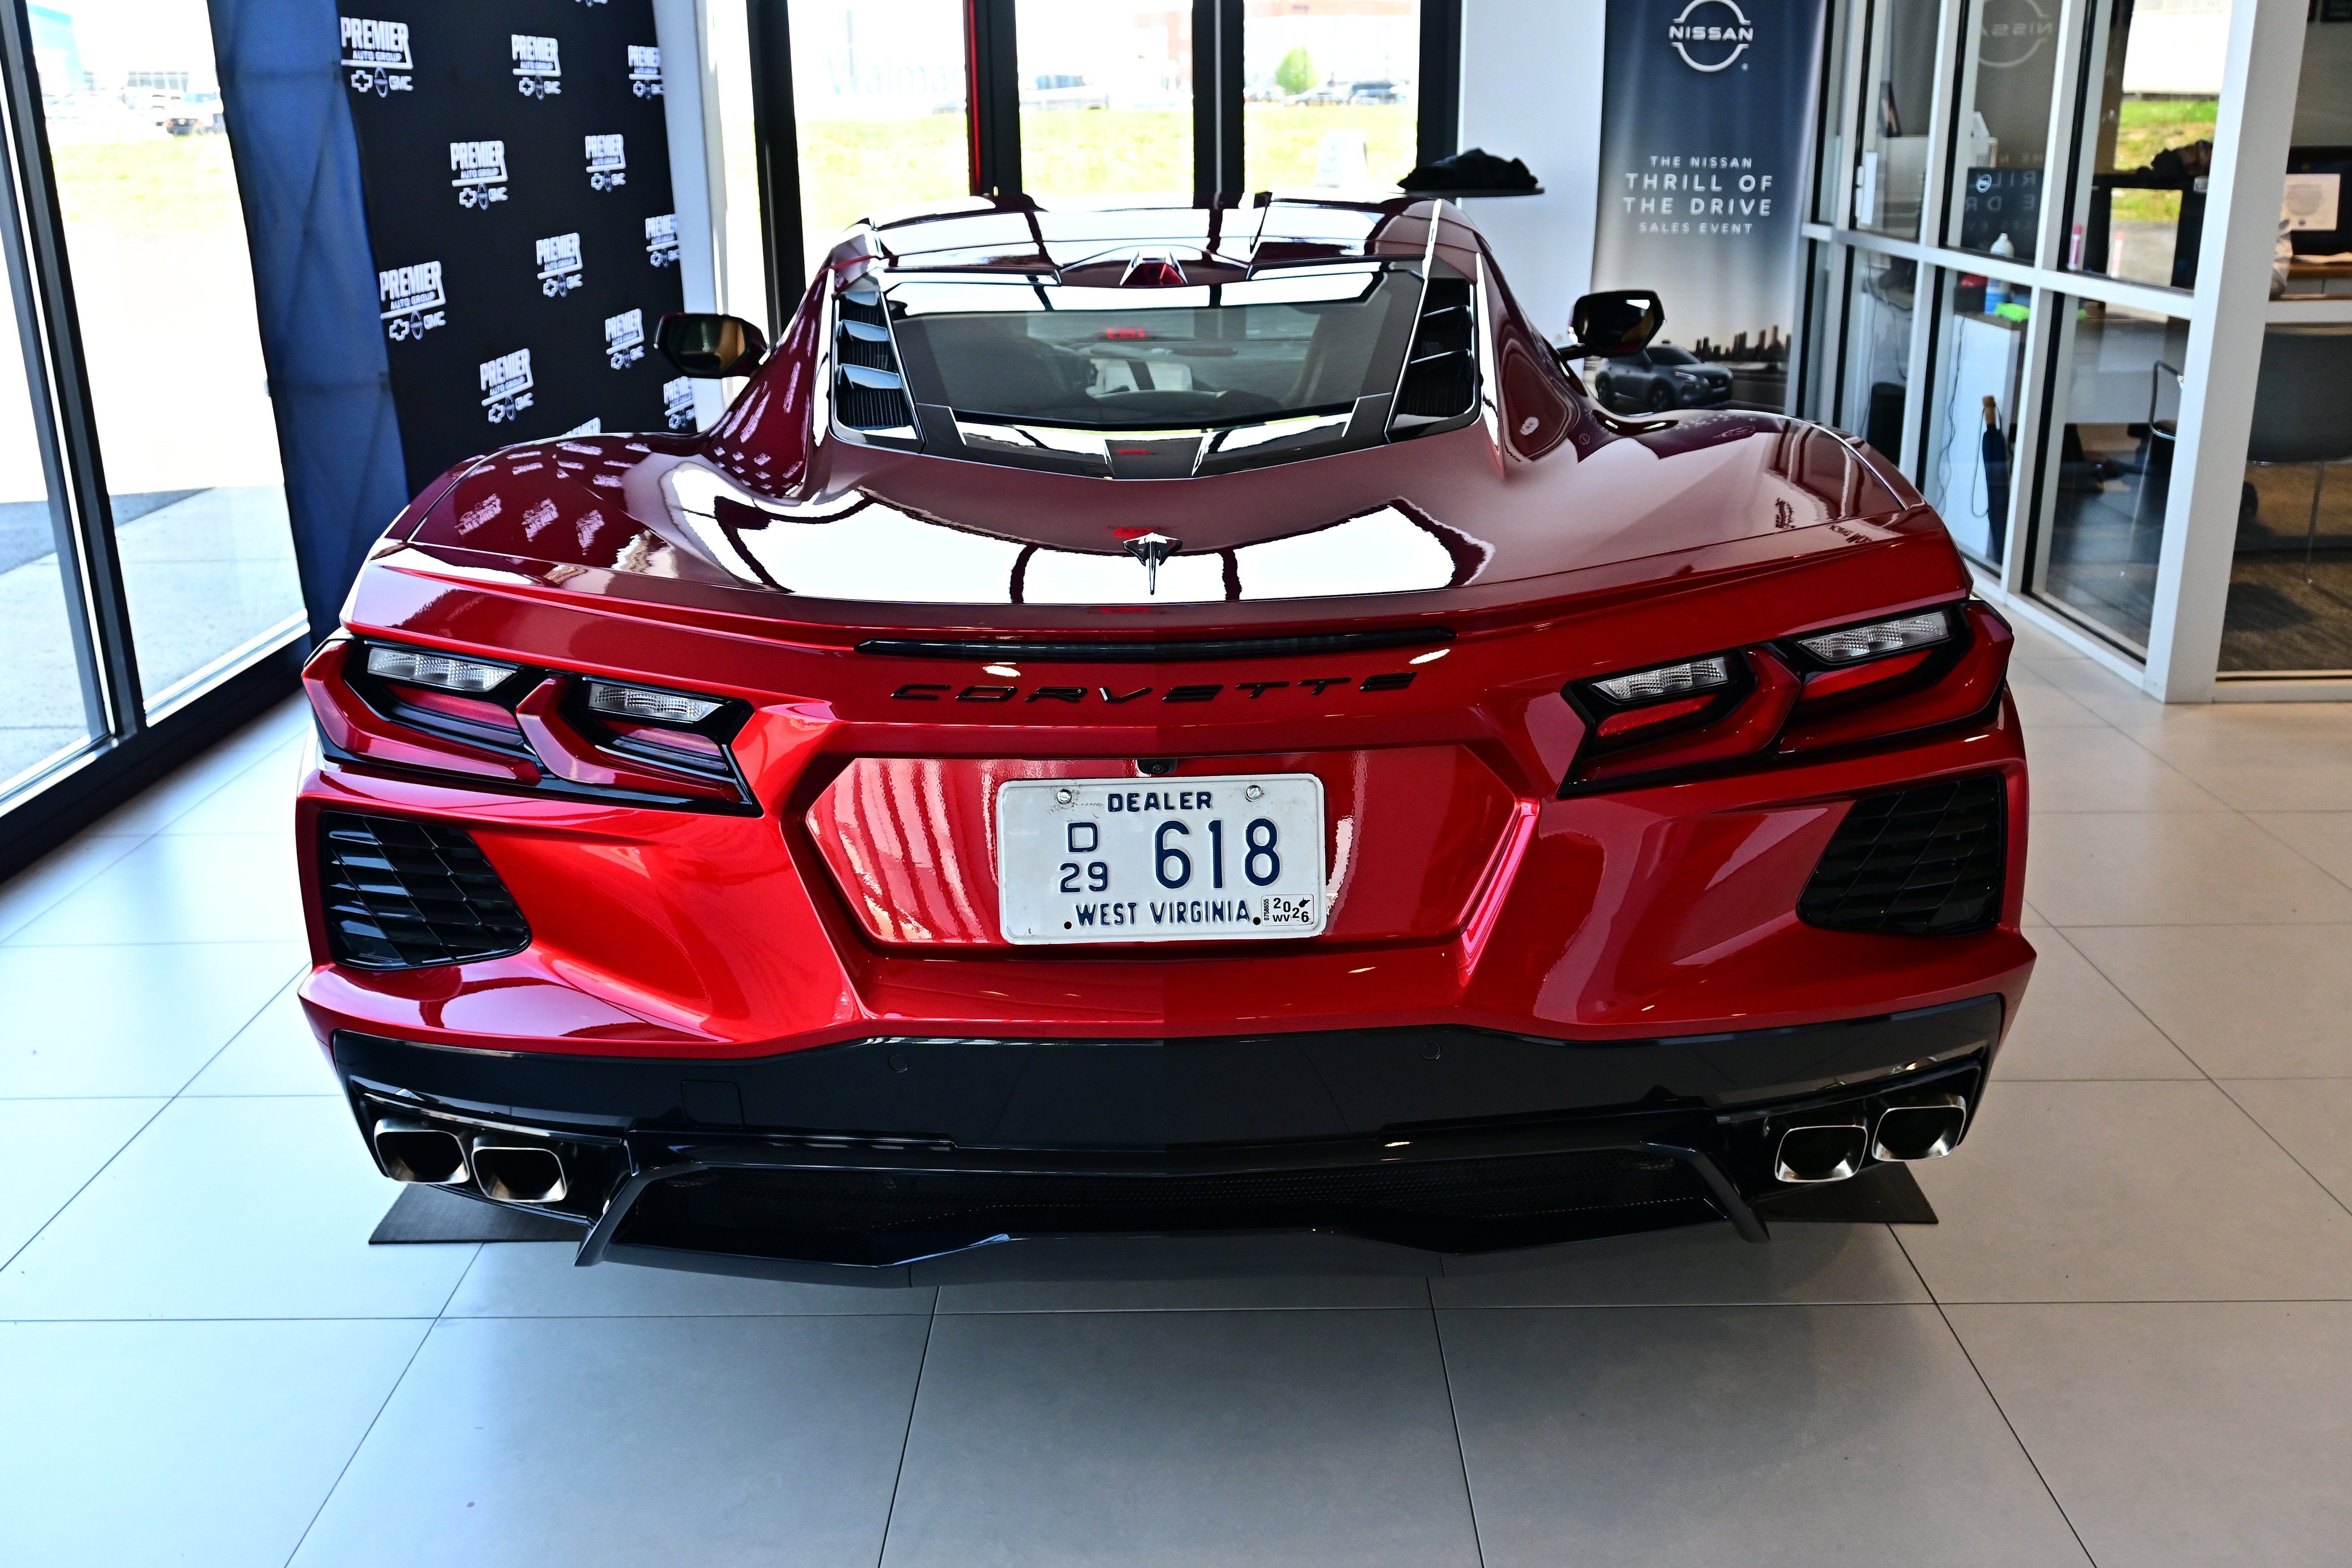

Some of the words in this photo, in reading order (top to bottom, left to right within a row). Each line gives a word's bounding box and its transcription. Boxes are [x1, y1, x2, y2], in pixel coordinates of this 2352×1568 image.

[340, 17, 408, 52] PREMIER
[1669, 26, 1753, 41] NISSAN
[353, 50, 375, 60] AUTO
[512, 34, 558, 63] PREMIER
[389, 75, 414, 91] GMC
[827, 56, 965, 95] Walmar
[450, 140, 504, 171] PREMIER
[585, 134, 623, 160] PREMIER
[1650, 155, 1681, 168] THE
[1690, 156, 1752, 169] NISSAN
[1625, 173, 1722, 193] THRILL
[1738, 174, 1772, 193] OF
[1622, 196, 1673, 215] THE
[1690, 198, 1771, 217] DRIVE
[645, 214, 677, 240] PREMIE
[1639, 222, 1690, 234] SALES
[1699, 223, 1753, 235] EVENT
[536, 232, 580, 265] PREMIER
[379, 261, 441, 302] PREMIER
[390, 297, 411, 310] AUTO
[411, 291, 436, 305] GROUP
[423, 311, 446, 330] GMC
[480, 348, 530, 391] PREMIER
[515, 392, 534, 411] GMC
[890, 672, 1418, 703] CORVETTE
[1108, 791, 1212, 812] DEALER
[1067, 822, 1098, 852] D
[1155, 819, 1280, 889] 618
[1060, 862, 1108, 893] 29
[1076, 902, 1137, 926] WEST
[1150, 900, 1250, 924] VIRGINIA
[1272, 914, 1290, 922] WV
